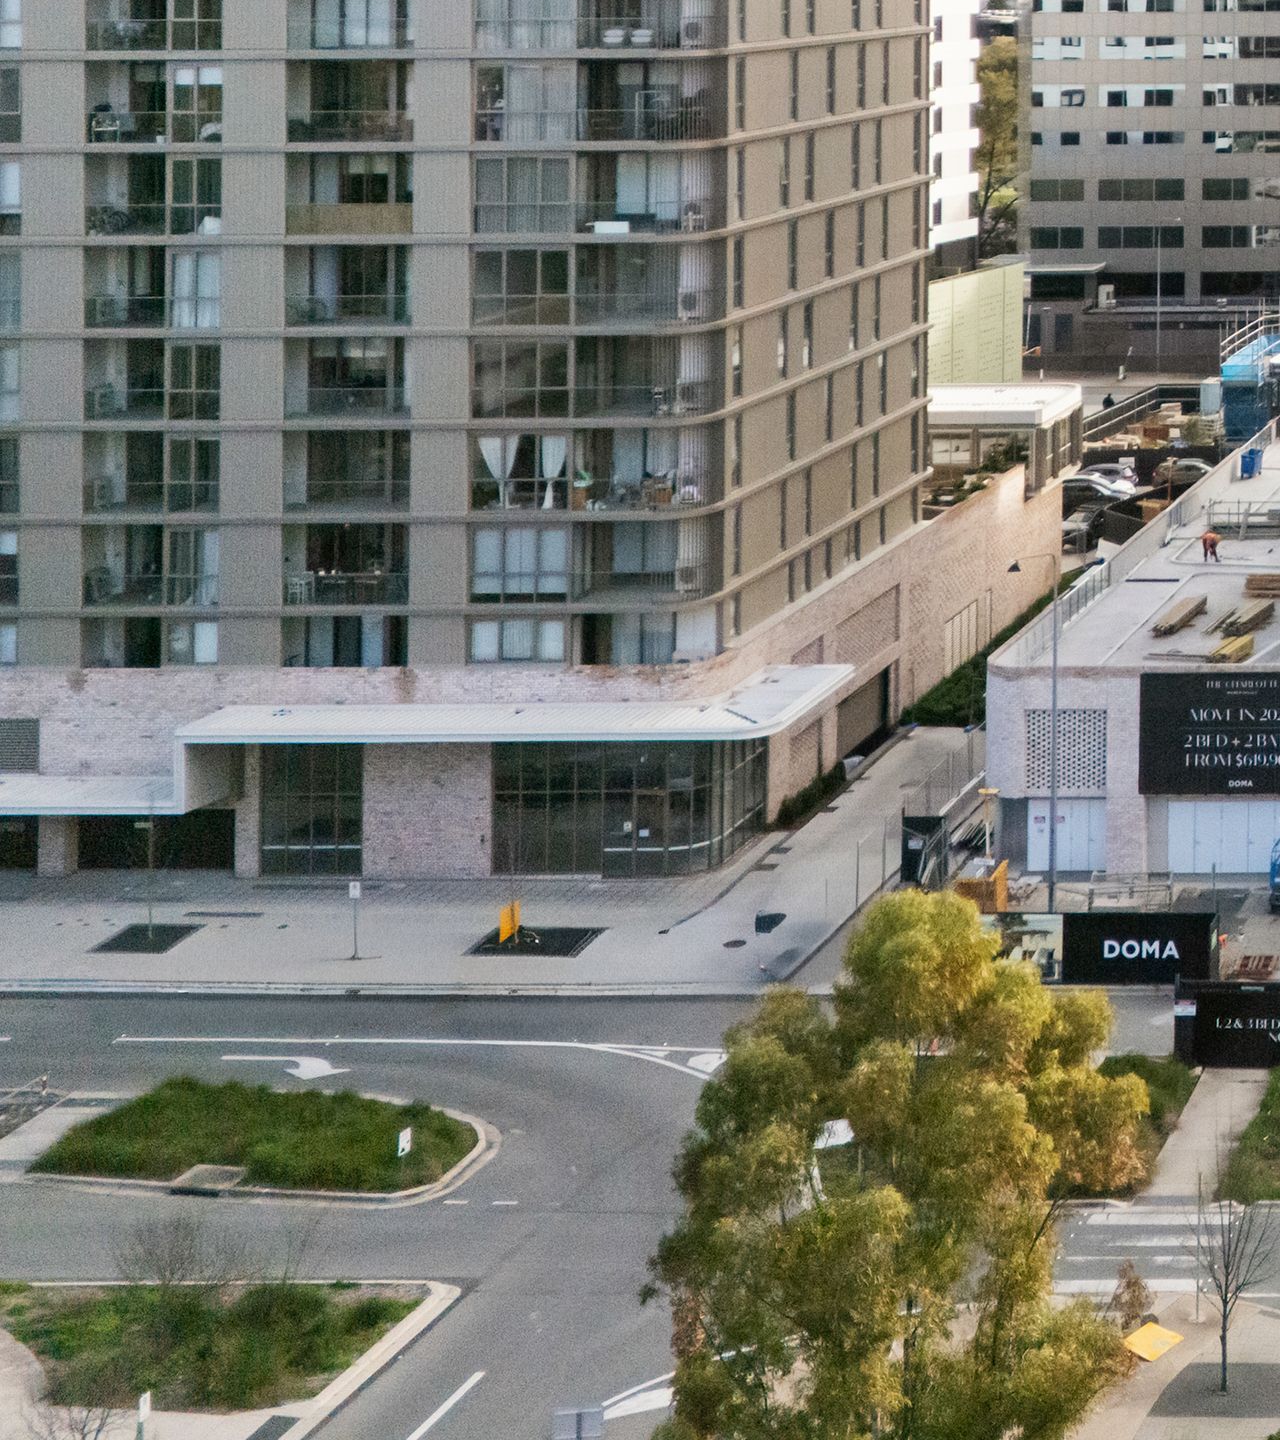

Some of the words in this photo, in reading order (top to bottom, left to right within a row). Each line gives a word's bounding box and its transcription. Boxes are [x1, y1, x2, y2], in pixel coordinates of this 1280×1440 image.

[1190, 709, 1231, 721] MOVE
[1240, 709, 1255, 721] IN
[1184, 734, 1192, 747] 2
[1196, 734, 1228, 747] BED
[1231, 737, 1240, 747] +
[1244, 734, 1253, 747] 2
[1185, 753, 1231, 766] FROM
[1228, 780, 1254, 788] DOMA
[1103, 939, 1180, 959] DOMA
[1232, 1017, 1243, 1029] &
